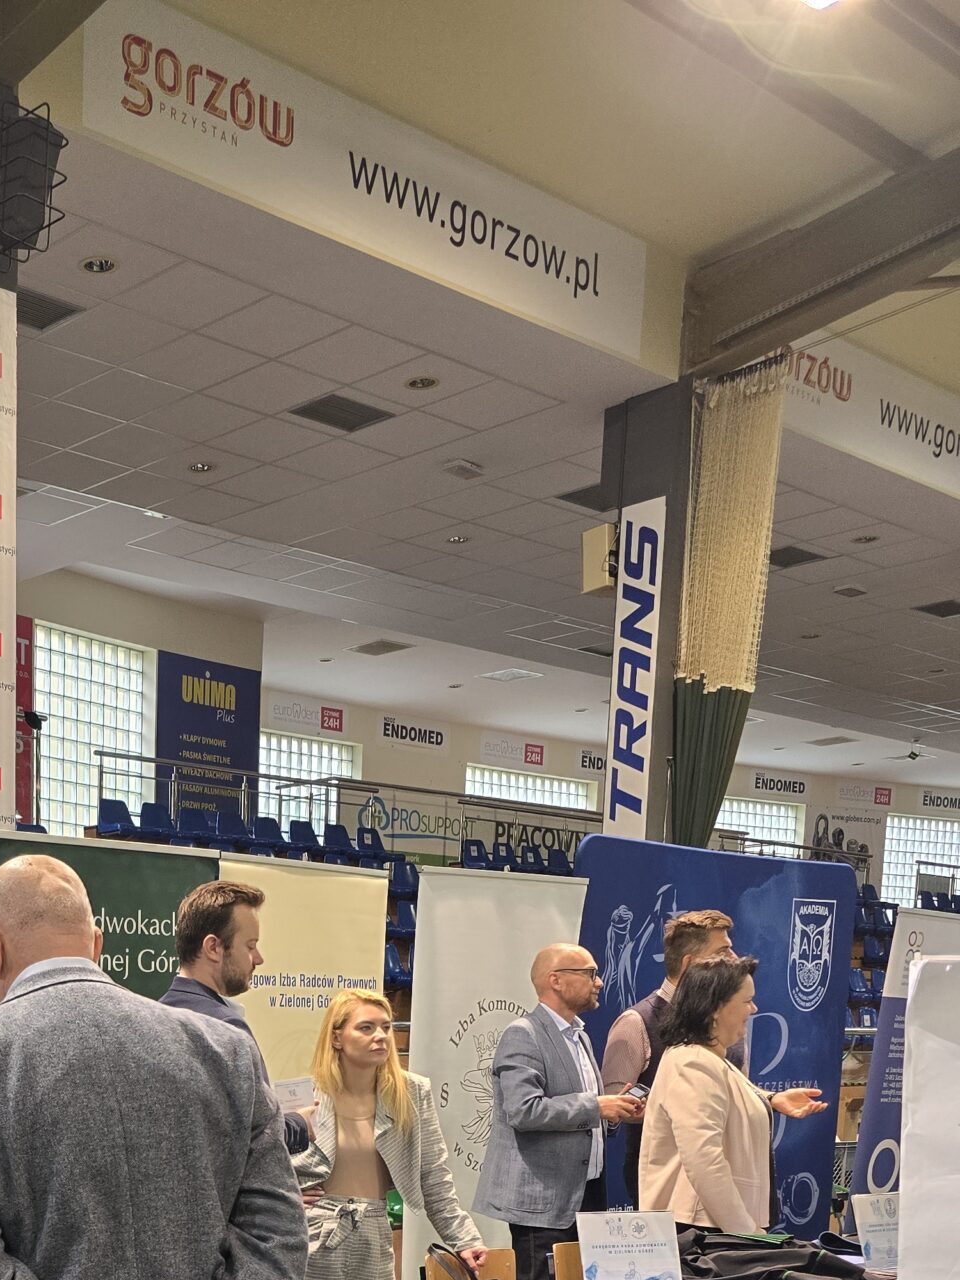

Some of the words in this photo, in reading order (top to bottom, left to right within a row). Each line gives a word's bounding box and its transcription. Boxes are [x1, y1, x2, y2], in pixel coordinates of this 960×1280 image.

[120, 34, 295, 148] gorzów
[159, 101, 239, 148] PRZYSTAŃ
[348, 151, 600, 298] www.gorzow.pl
[608, 519, 660, 822] TRANS
[216, 709, 236, 724] Plus
[323, 716, 340, 729] 24H
[201, 736, 227, 748] DYMOWE
[382, 722, 444, 747] ENDOMED
[202, 751, 232, 765] ŚWIETLNE
[526, 751, 541, 764] 24H
[205, 768, 233, 782] DACHOWE
[181, 783, 203, 795] FASADY
[754, 777, 806, 794] ENDOMED
[875, 794, 890, 804] 24H
[798, 904, 830, 917] AKADEMIA
[278, 972, 297, 987] Izba
[299, 972, 335, 989] Radców
[336, 974, 377, 992] Prawnych
[269, 995, 277, 1007] w
[279, 994, 315, 1011] Zielonej
[449, 1012, 477, 1048] Izba
[453, 1142, 464, 1157] w
